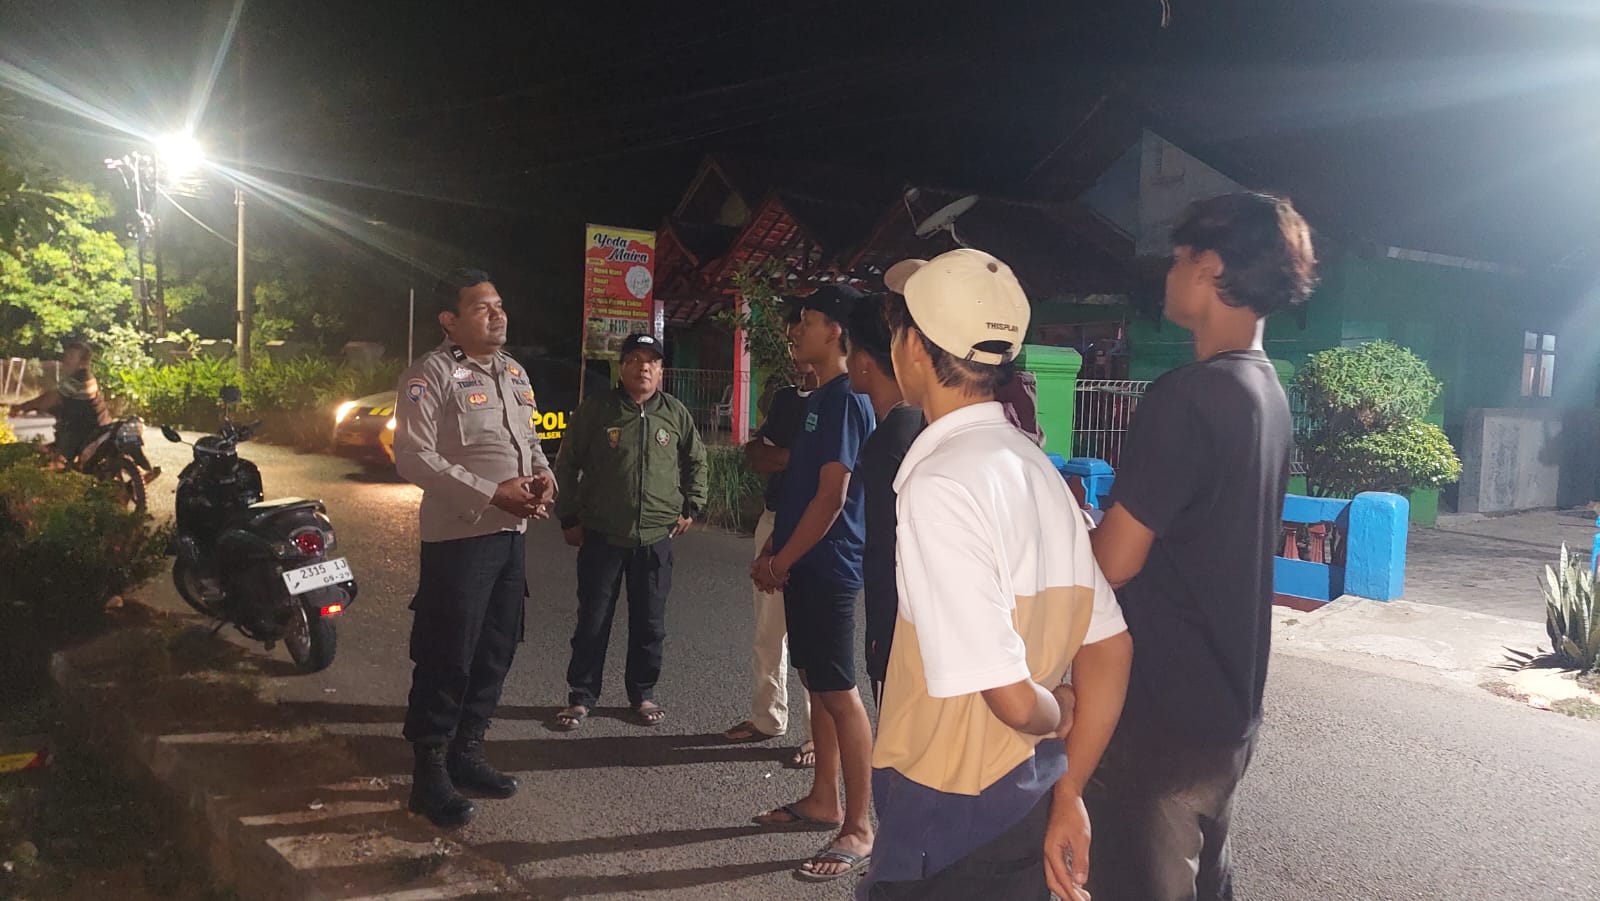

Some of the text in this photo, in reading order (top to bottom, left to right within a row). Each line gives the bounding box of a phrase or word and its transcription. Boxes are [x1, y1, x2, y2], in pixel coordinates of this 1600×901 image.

[593, 232, 628, 248] Yoda
[607, 249, 648, 263] Maira
[285, 573, 292, 582] T
[300, 564, 327, 579] 2315
